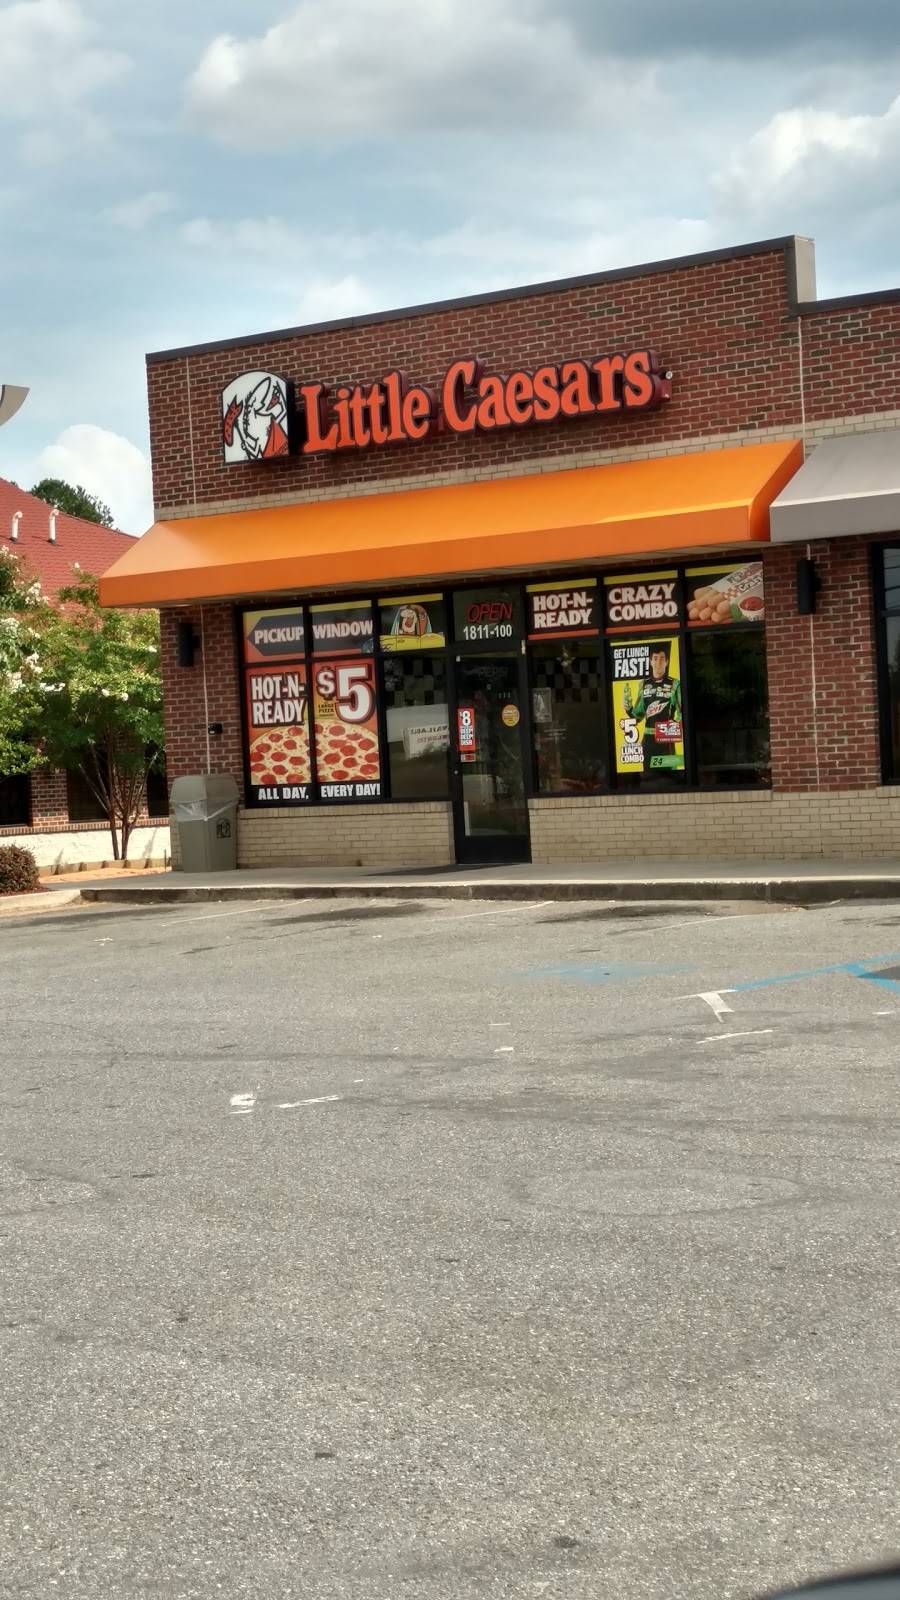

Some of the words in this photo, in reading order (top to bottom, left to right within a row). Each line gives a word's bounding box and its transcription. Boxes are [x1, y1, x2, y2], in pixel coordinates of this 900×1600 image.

[301, 371, 429, 454] Little
[444, 350, 654, 433] Caesars
[533, 591, 593, 612] HOT-N-
[608, 583, 676, 604] CRAZY
[466, 602, 513, 624] OPEN
[533, 608, 591, 629] READY
[609, 601, 678, 622] COMBO
[254, 626, 304, 645] PICKUP
[312, 619, 373, 640] WINDOW
[463, 624, 513, 641] 1811-100
[613, 648, 626, 659] GET
[626, 646, 650, 659] LUNCH
[614, 657, 650, 679] FAST!
[251, 673, 305, 700] HOT-N-
[317, 665, 371, 722] $5
[252, 698, 305, 726] READY
[621, 745, 644, 755] LUNCH
[621, 754, 645, 763] COMBO
[258, 787, 280, 801] ALL
[320, 784, 354, 798] EVERY
[356, 783, 381, 797] DAY!
